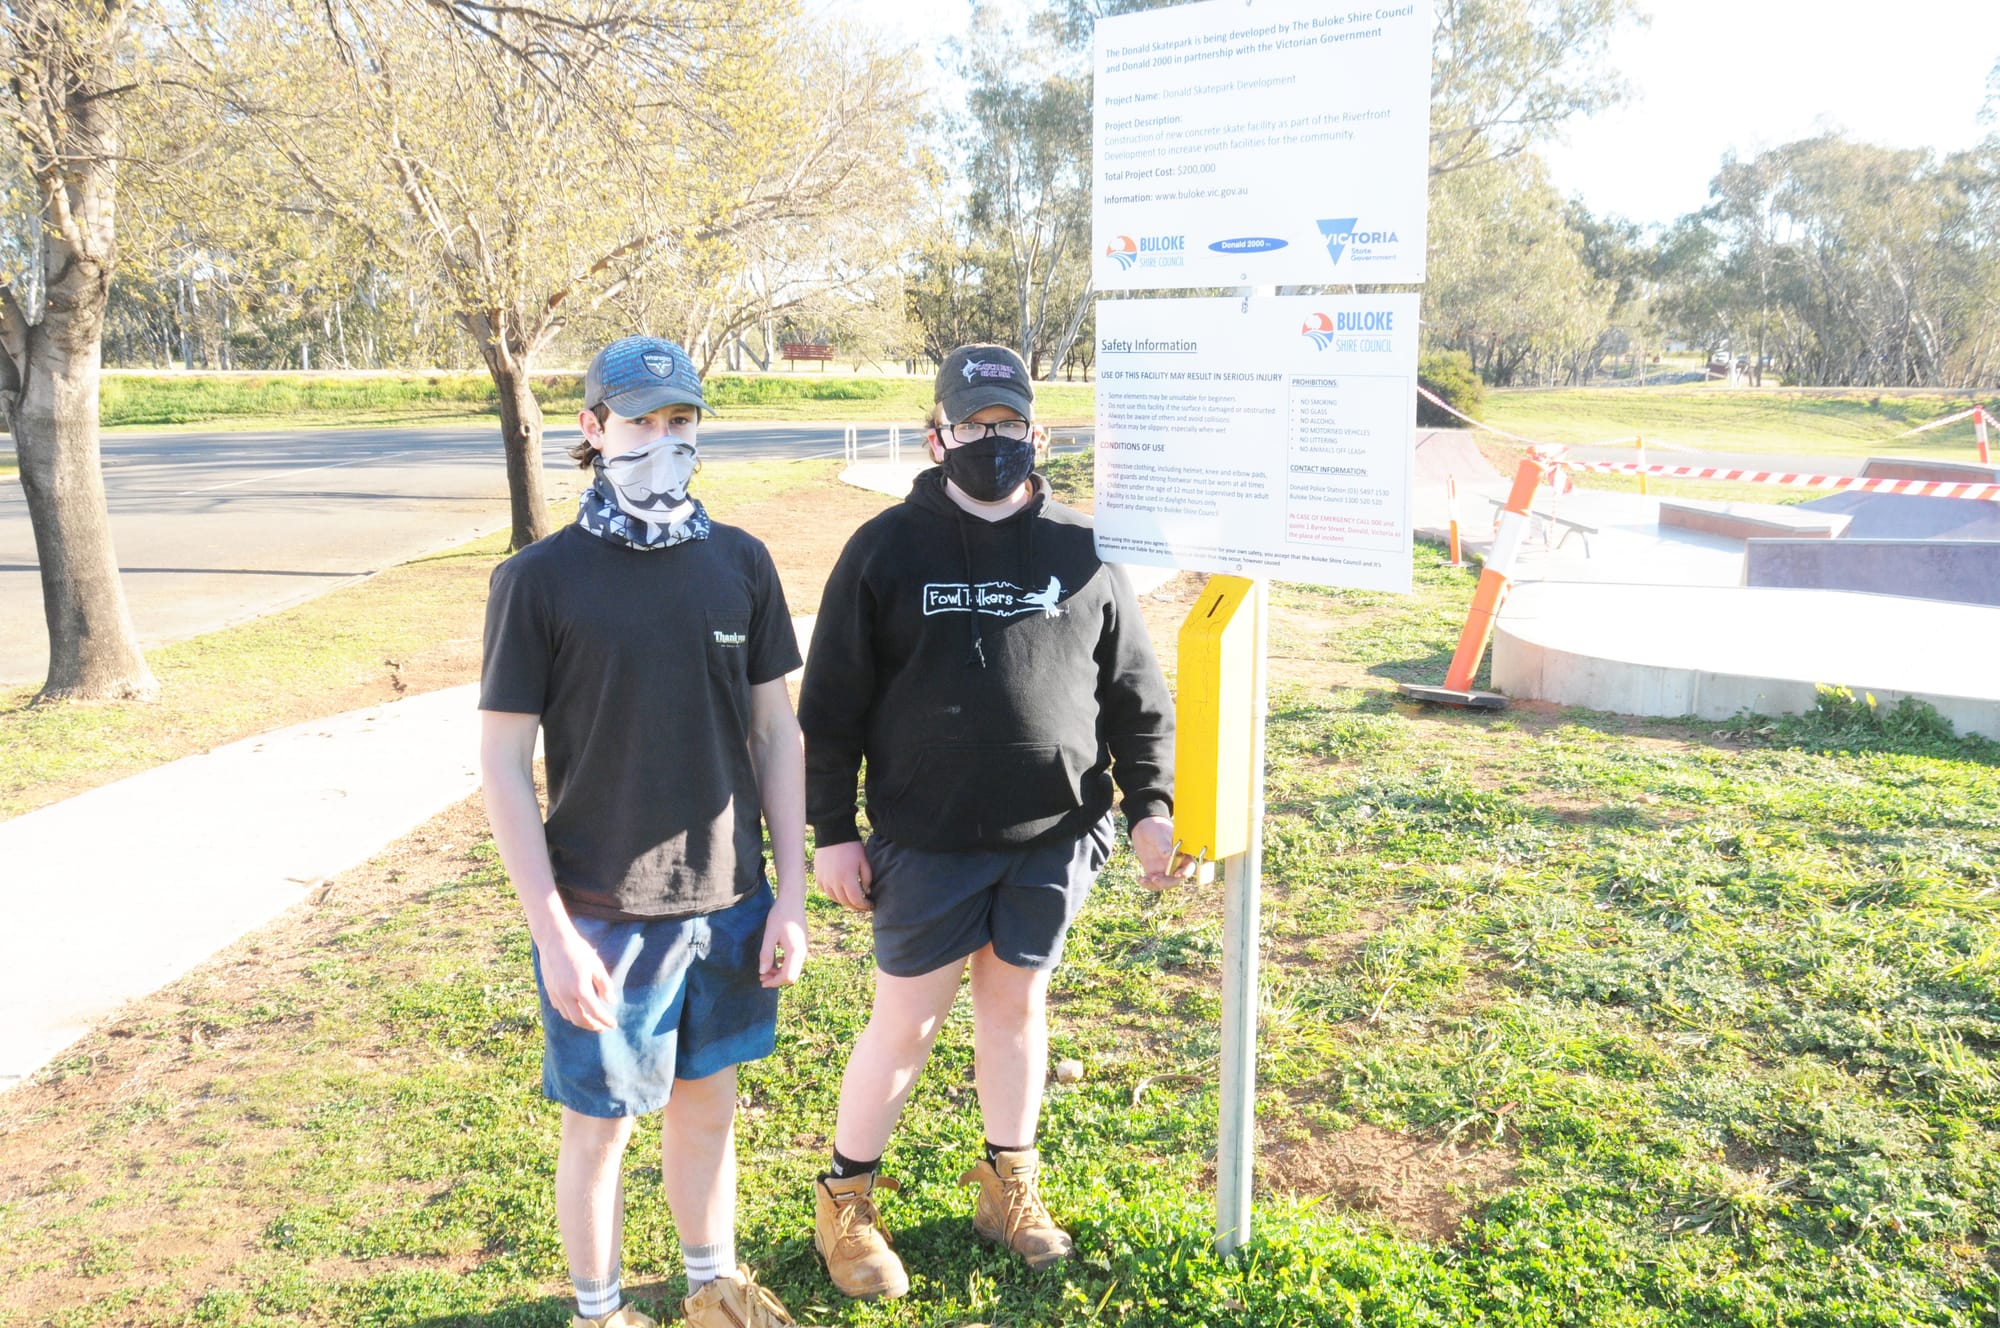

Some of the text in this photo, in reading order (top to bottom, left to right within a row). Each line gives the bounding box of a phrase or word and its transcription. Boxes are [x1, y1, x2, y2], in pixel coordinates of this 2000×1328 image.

[1106, 4, 1414, 59] The Donald Skatepark is being developed by The Buloke Shire Council
[1105, 26, 1382, 74] and Donald 2000 in partnership with the Victorian Government
[1105, 74, 1296, 107] Project Name: Donald Skatepark Development
[1104, 107, 1391, 146] Construction of new concrete skate facility as part of the Riverfront
[1105, 114, 1183, 132] Project Description:
[1104, 146, 1156, 160] Development
[1157, 145, 1166, 155] to
[1168, 144, 1202, 154] increase
[1203, 139, 1228, 154] youth
[1230, 137, 1265, 149] facilities
[1268, 136, 1280, 146] for
[1282, 134, 1298, 145] the
[1105, 163, 1216, 182] Total Project Cost: $200,000
[1104, 188, 1248, 204] Information: www.buloke.vic.gov.au
[1140, 236, 1184, 252] BULOKE
[1222, 241, 1246, 249] Donald
[1247, 240, 1264, 248] 2000
[1323, 232, 1398, 245] VICTORIA
[1140, 256, 1184, 267] SHIRE COUNCIL
[1337, 312, 1393, 331] BULOKE
[1101, 339, 1197, 352] Safety Information
[1336, 339, 1392, 352] SHIRE COUNCIL
[1101, 371, 1282, 382] USE OF THIS FACILITY MAY RESULT IN SERIOUS INJURY
[1108, 392, 1122, 400] Some
[1123, 392, 1148, 400] elements
[1148, 394, 1160, 402] may
[1100, 442, 1165, 452] CONDITIONS OF USE
[1290, 464, 1318, 472] CONTACT
[1342, 557, 1362, 565] Council
[930, 588, 1013, 606] Fowl Tlkers
